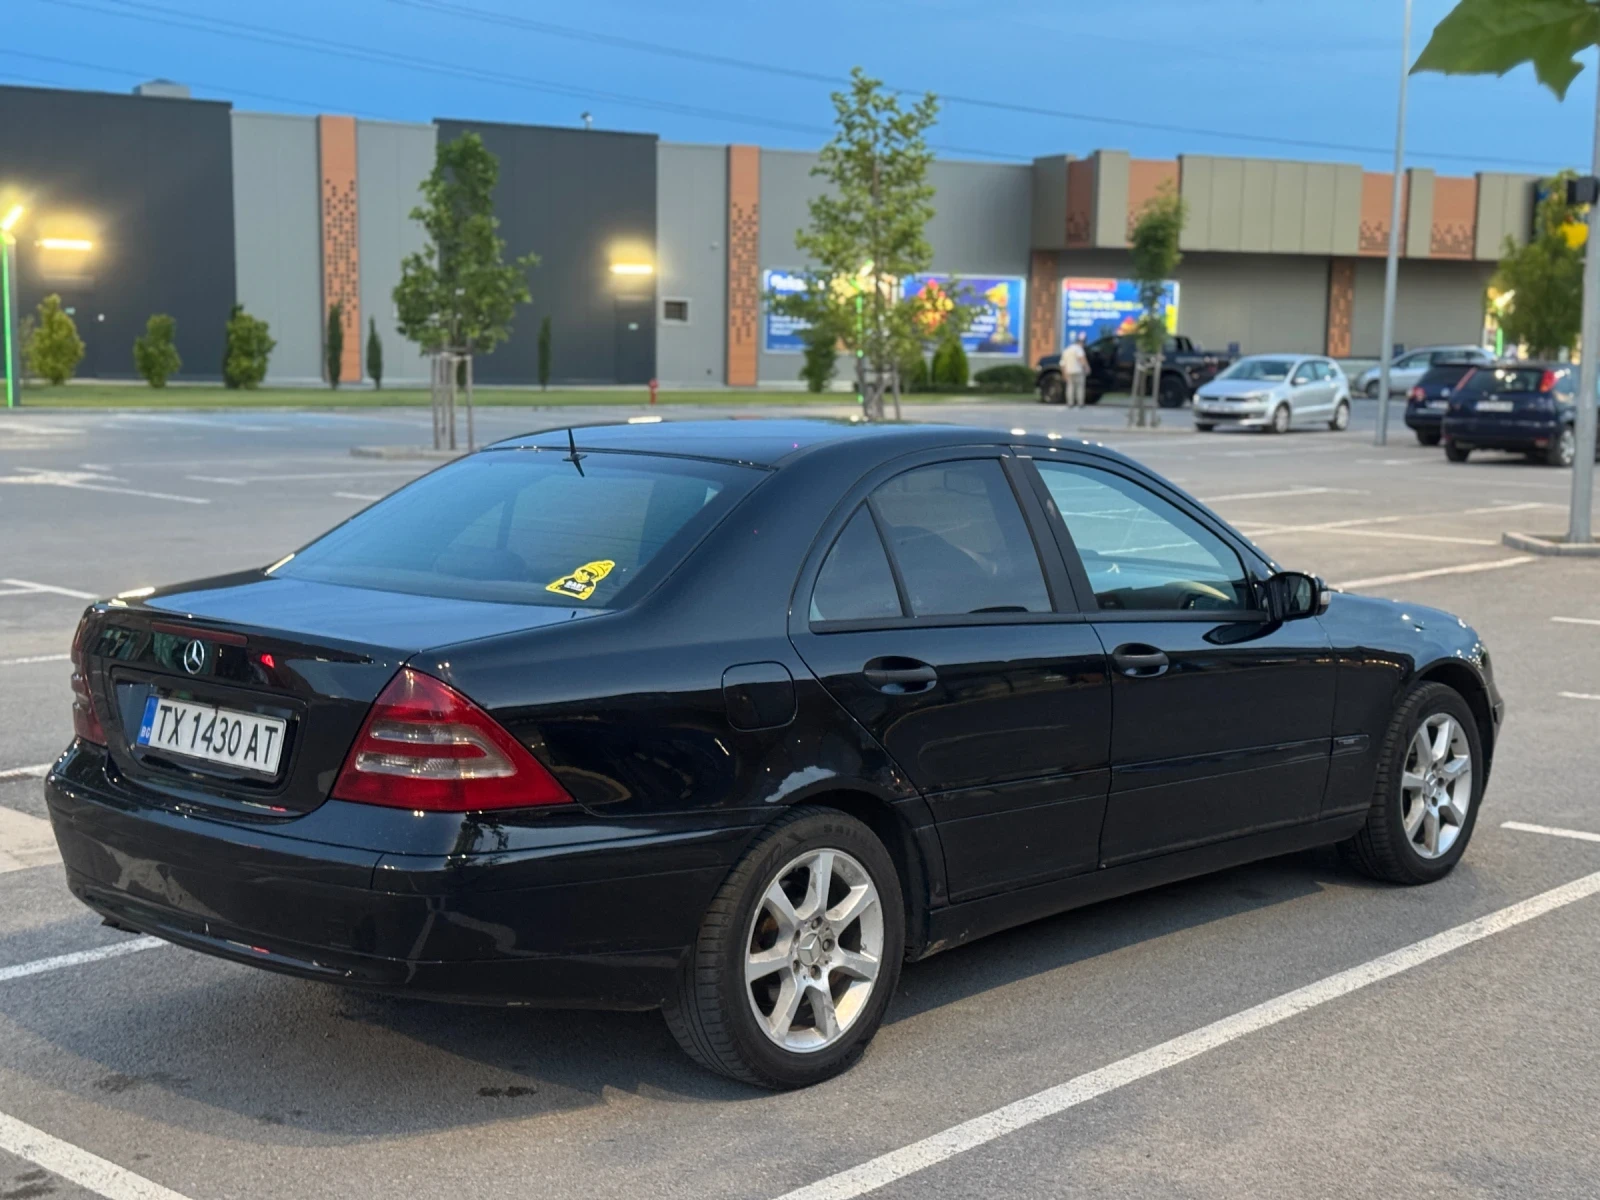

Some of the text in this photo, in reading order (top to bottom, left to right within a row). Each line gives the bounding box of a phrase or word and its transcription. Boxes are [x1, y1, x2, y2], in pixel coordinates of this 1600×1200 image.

[140, 726, 151, 738] BG
[157, 704, 279, 764] TX 1430 AT
